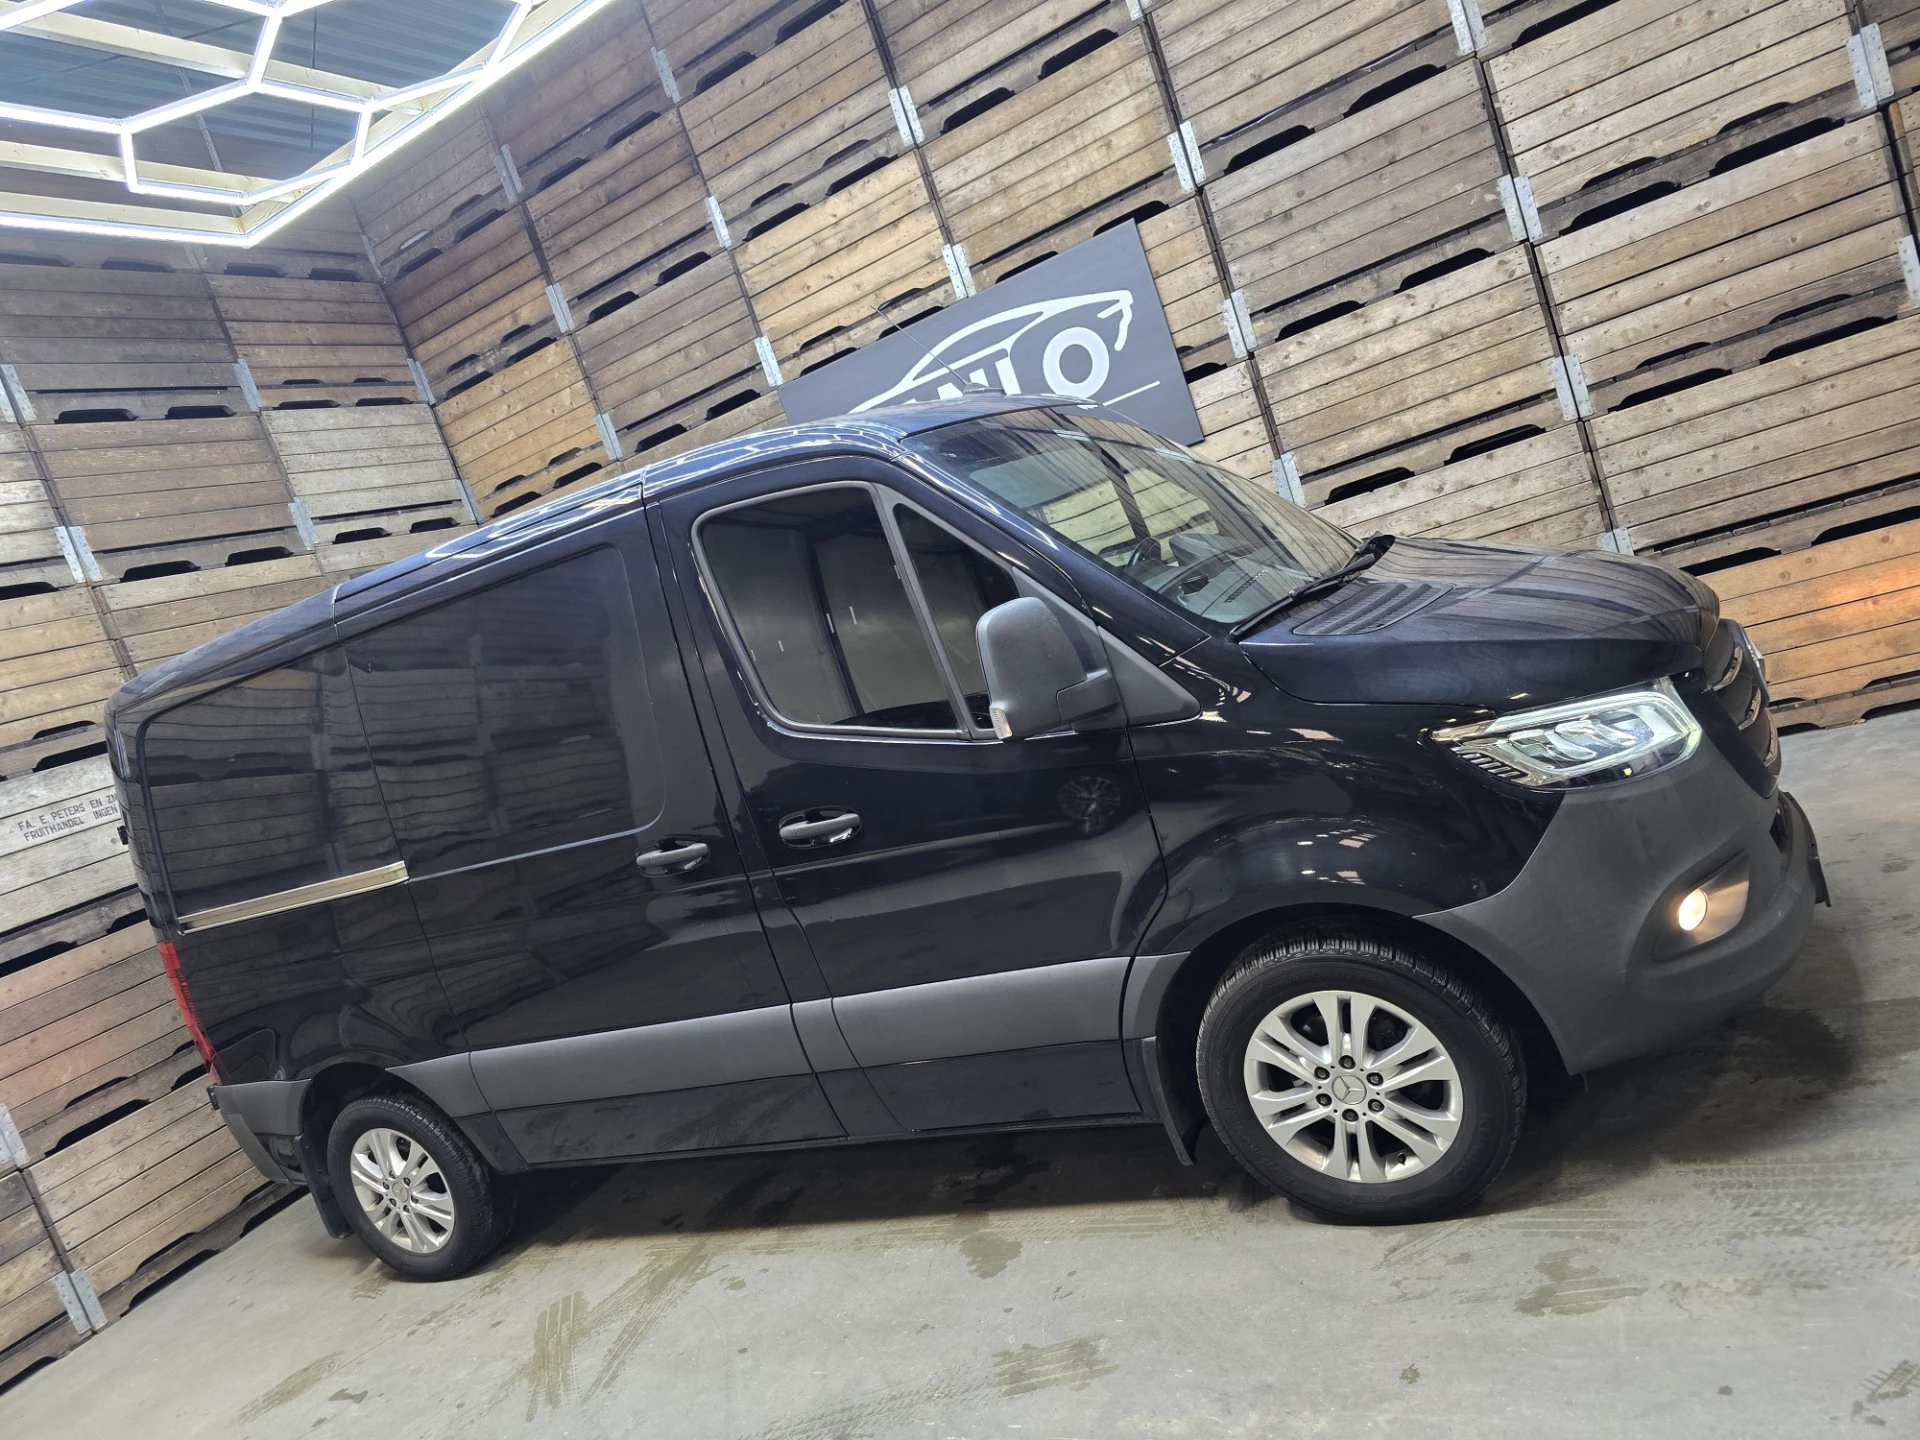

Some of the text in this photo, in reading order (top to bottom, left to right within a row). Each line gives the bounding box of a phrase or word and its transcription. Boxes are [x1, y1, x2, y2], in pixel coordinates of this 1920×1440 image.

[17, 819, 35, 832] FA.
[51, 803, 86, 821] PETERS
[90, 798, 103, 809] EN
[23, 805, 118, 842] FRUITHANDEL INGEN
